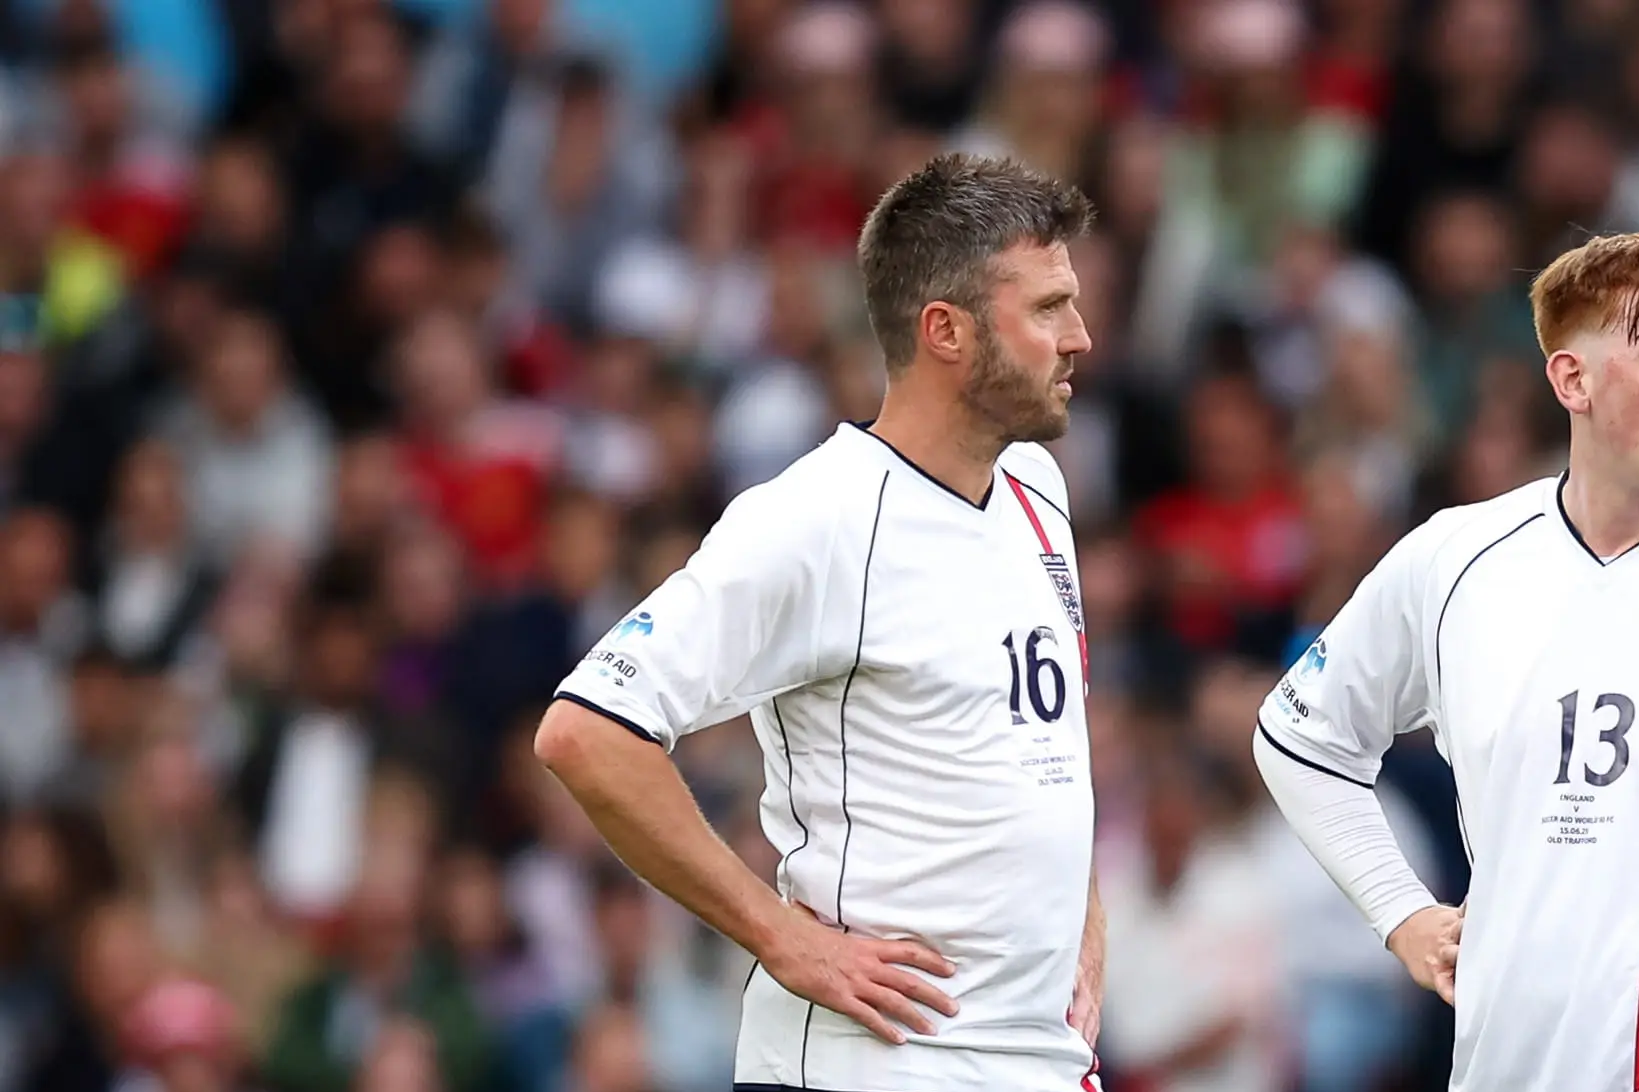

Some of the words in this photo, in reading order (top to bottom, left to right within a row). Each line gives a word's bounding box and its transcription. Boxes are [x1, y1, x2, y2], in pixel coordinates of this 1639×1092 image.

[612, 660, 637, 679] AID
[1001, 625, 1067, 726] 16
[1292, 698, 1309, 718] AID
[1552, 689, 1636, 787] 13
